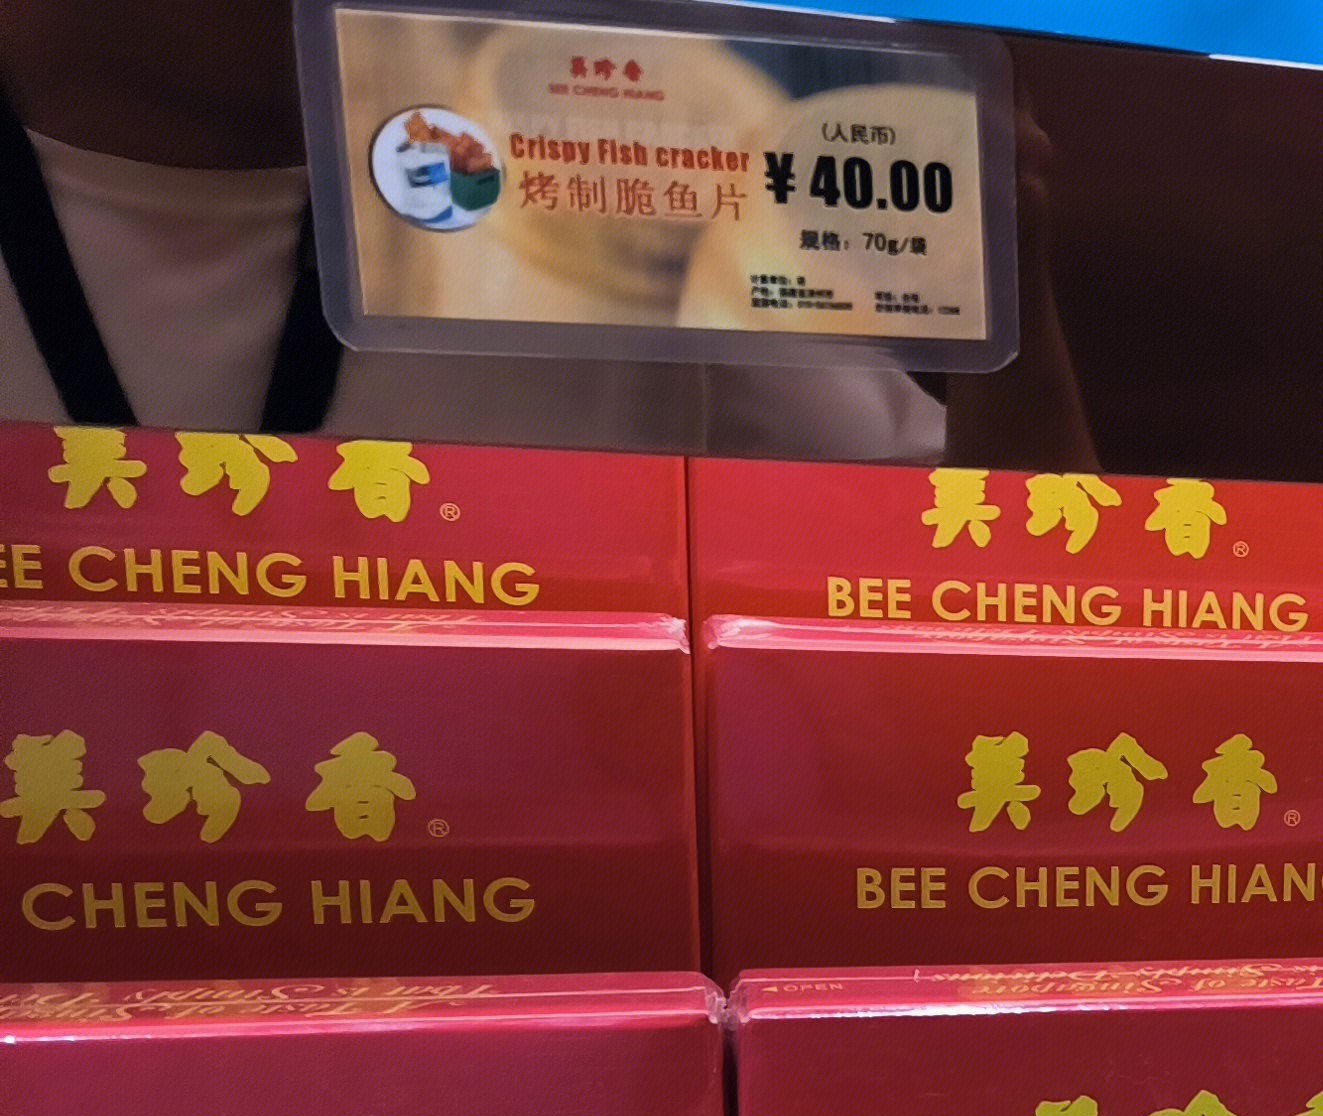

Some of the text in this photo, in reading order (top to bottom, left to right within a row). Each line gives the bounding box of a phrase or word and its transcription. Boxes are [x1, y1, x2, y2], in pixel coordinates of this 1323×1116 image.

[509, 133, 749, 172] Crispy Fish cracker
[517, 170, 748, 221] 烤制脆鱼片
[921, 468, 1227, 559] 美珍香
[69, 546, 540, 605] CHENG HIANG
[827, 577, 1308, 632] BEE CHENG HIANG
[0, 730, 416, 844] 美珍香
[957, 731, 1277, 832] 美珍香
[21, 878, 535, 931] CHENG HIANG
[857, 867, 946, 909] BEE
[968, 864, 1168, 910] CHENG
